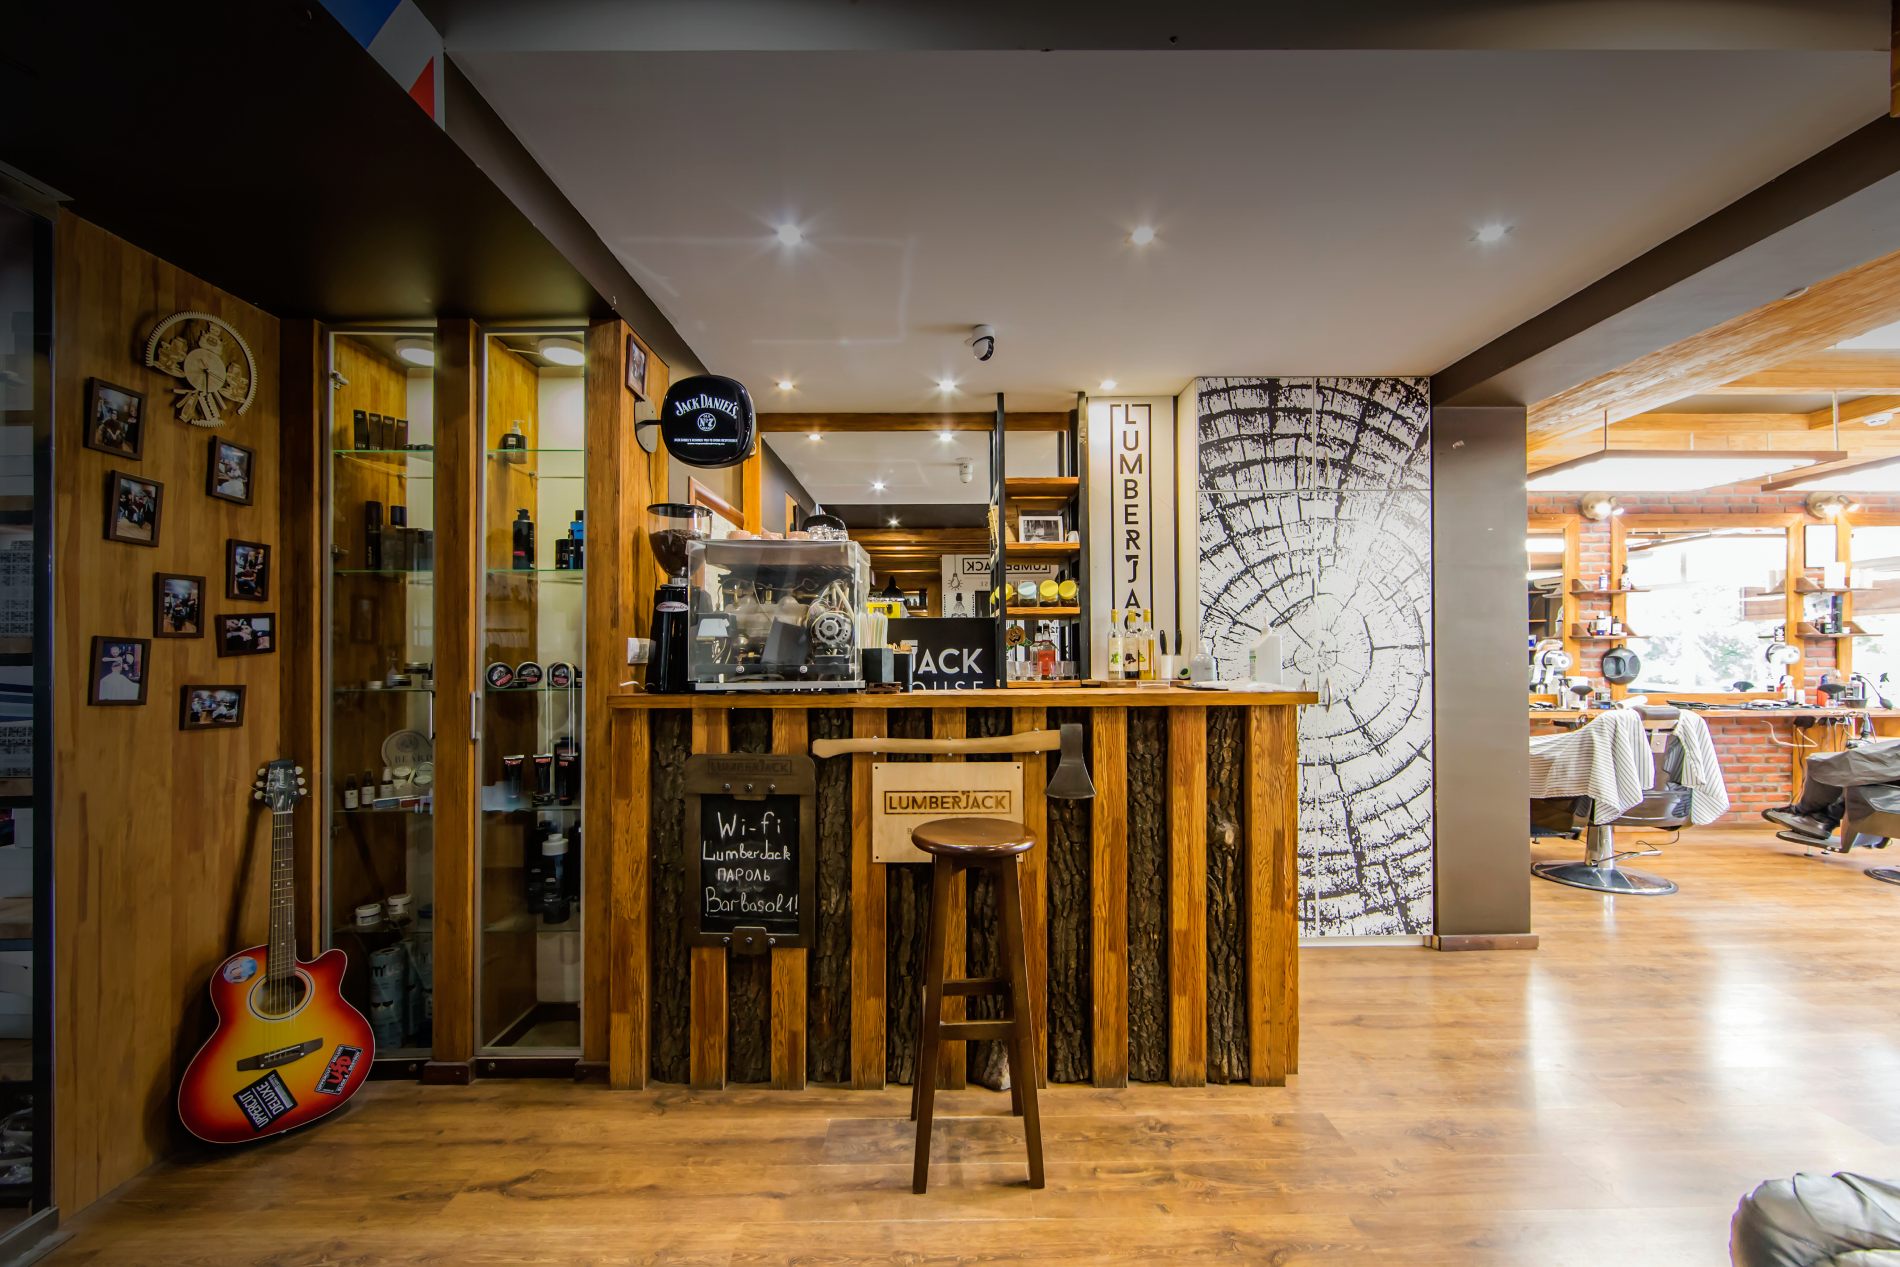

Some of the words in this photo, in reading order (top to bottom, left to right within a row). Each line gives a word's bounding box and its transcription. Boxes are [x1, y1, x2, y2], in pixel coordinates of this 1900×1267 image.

[675, 398, 700, 416] JACK
[700, 394, 738, 417] DANIEL'S
[1119, 404, 1143, 634] LUMBERJAC
[889, 791, 1006, 809] LUMBERJACK
[717, 811, 781, 838] Wi-fi
[238, 1091, 269, 1128] UPPERCUT
[256, 1081, 285, 1115] DELUXE
